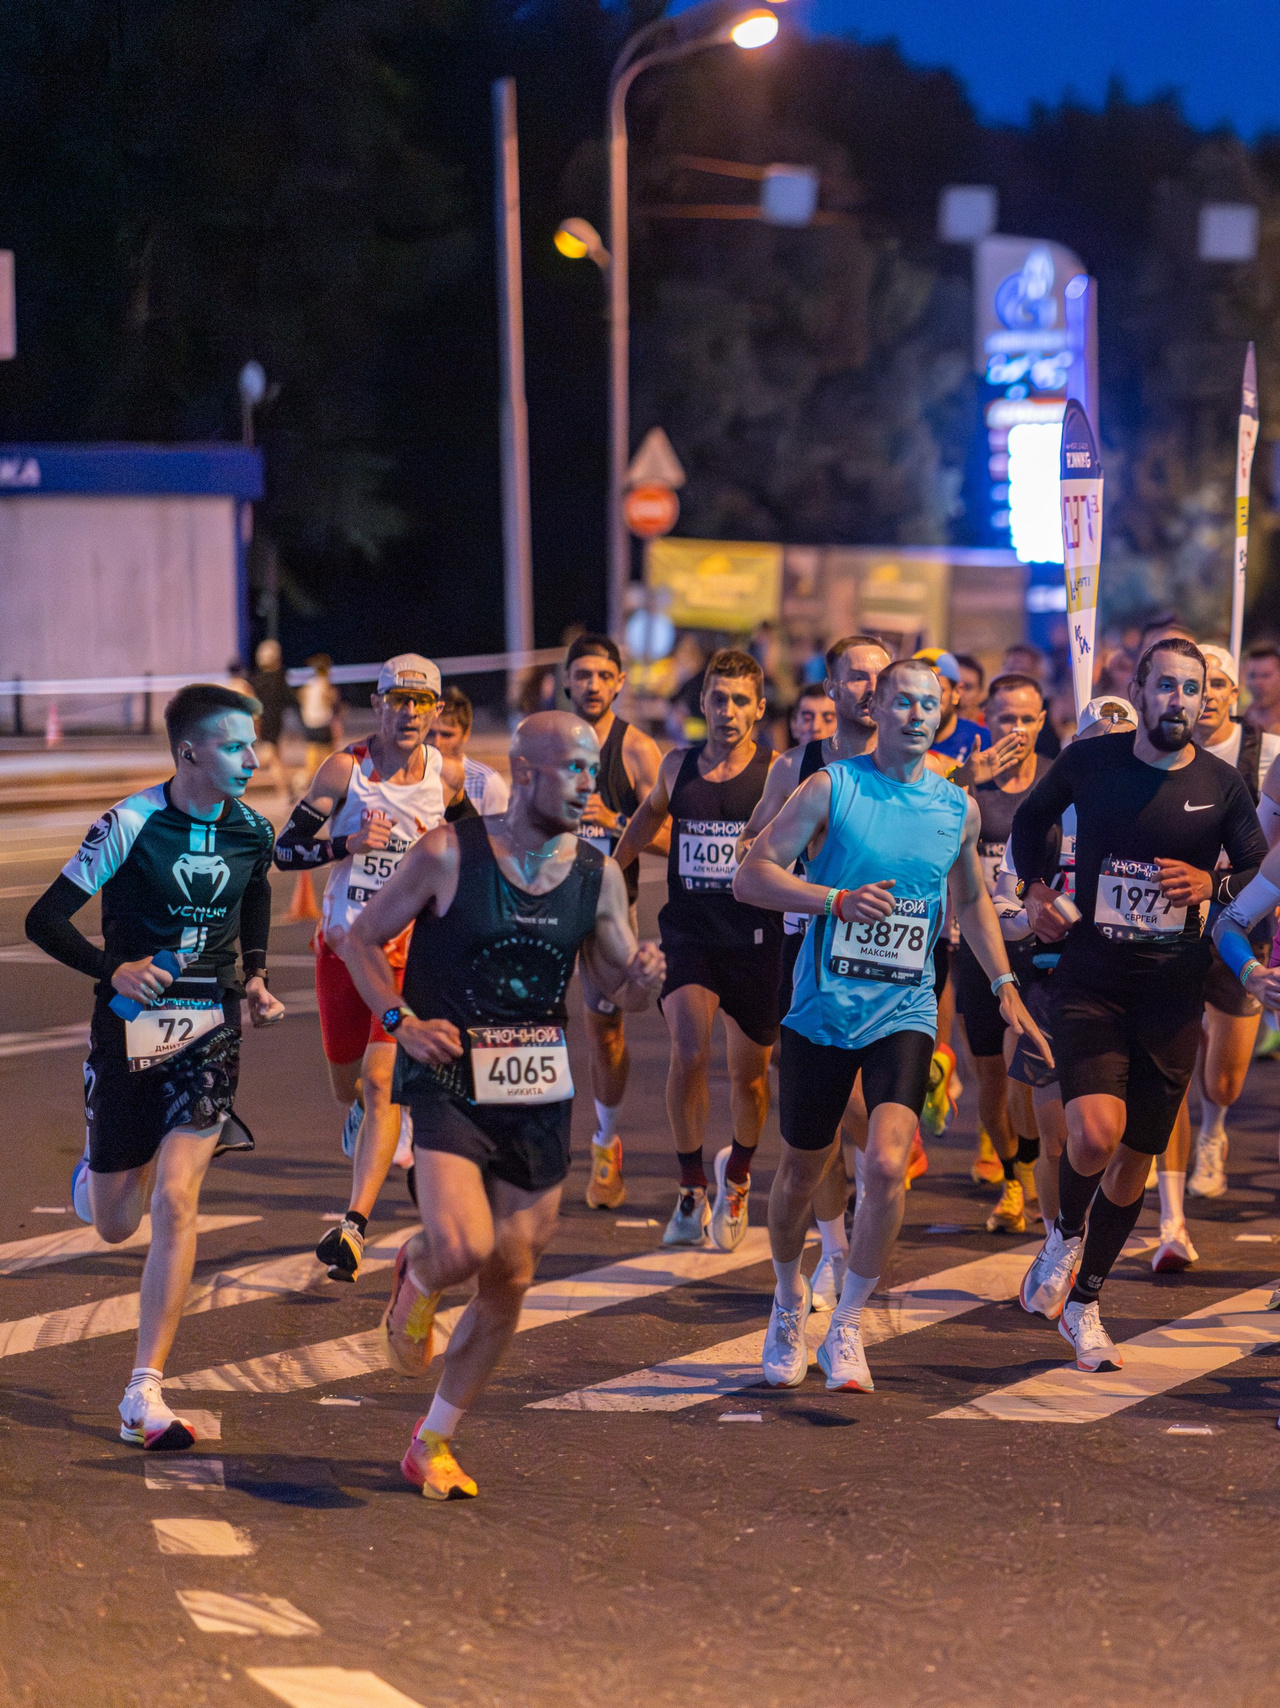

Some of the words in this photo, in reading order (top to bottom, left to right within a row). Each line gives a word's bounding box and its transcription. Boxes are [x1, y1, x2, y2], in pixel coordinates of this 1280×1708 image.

[363, 855, 401, 878] 55
[1125, 913, 1158, 924] СЕРГЕЙ
[844, 920, 925, 952] 13878
[860, 947, 899, 960] МАКСИМ
[158, 1017, 195, 1043] 72
[489, 1056, 557, 1085] 4065
